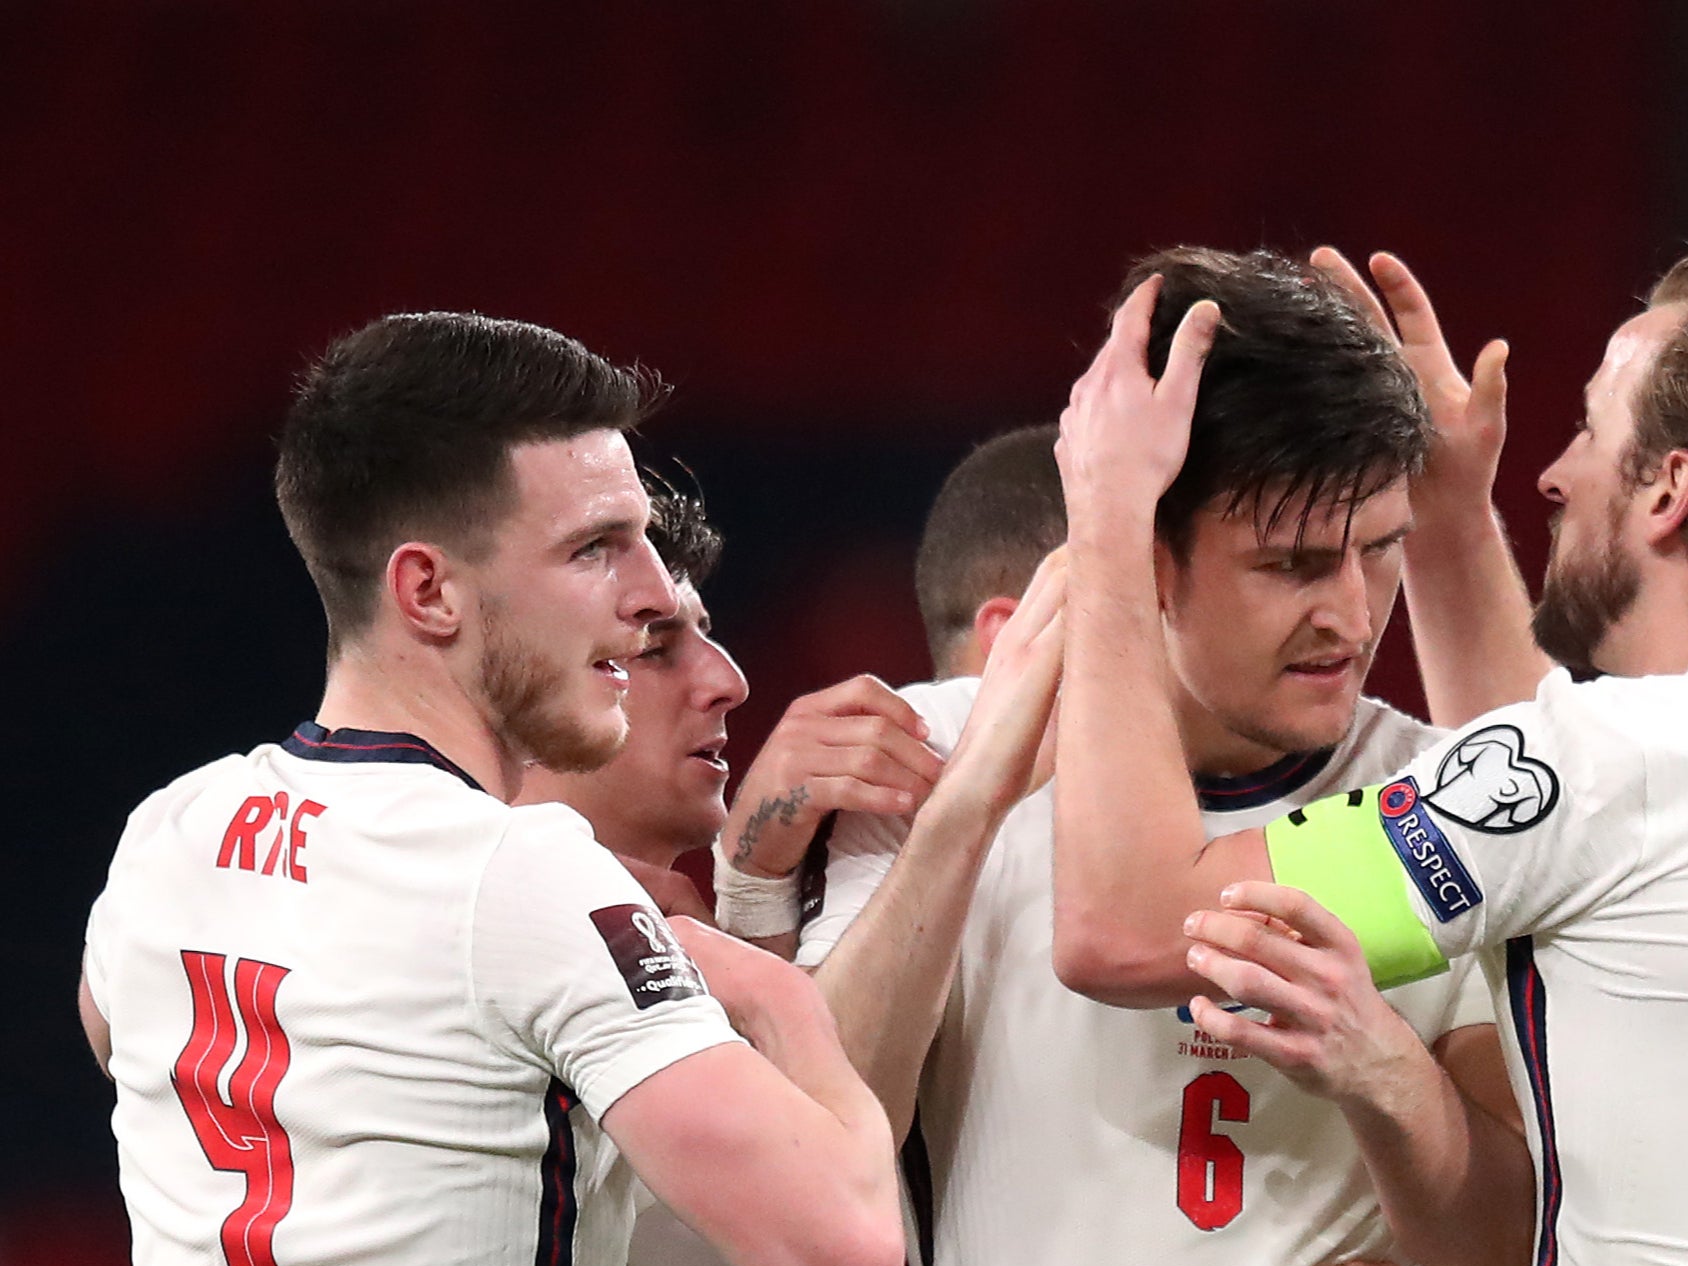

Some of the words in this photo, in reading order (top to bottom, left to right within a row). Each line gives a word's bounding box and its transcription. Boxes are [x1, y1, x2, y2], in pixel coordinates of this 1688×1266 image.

[1397, 813, 1471, 911] RESPECT
[1178, 1042, 1188, 1056] 31
[1190, 1044, 1229, 1060] MARCH
[1177, 1070, 1250, 1232] 6
